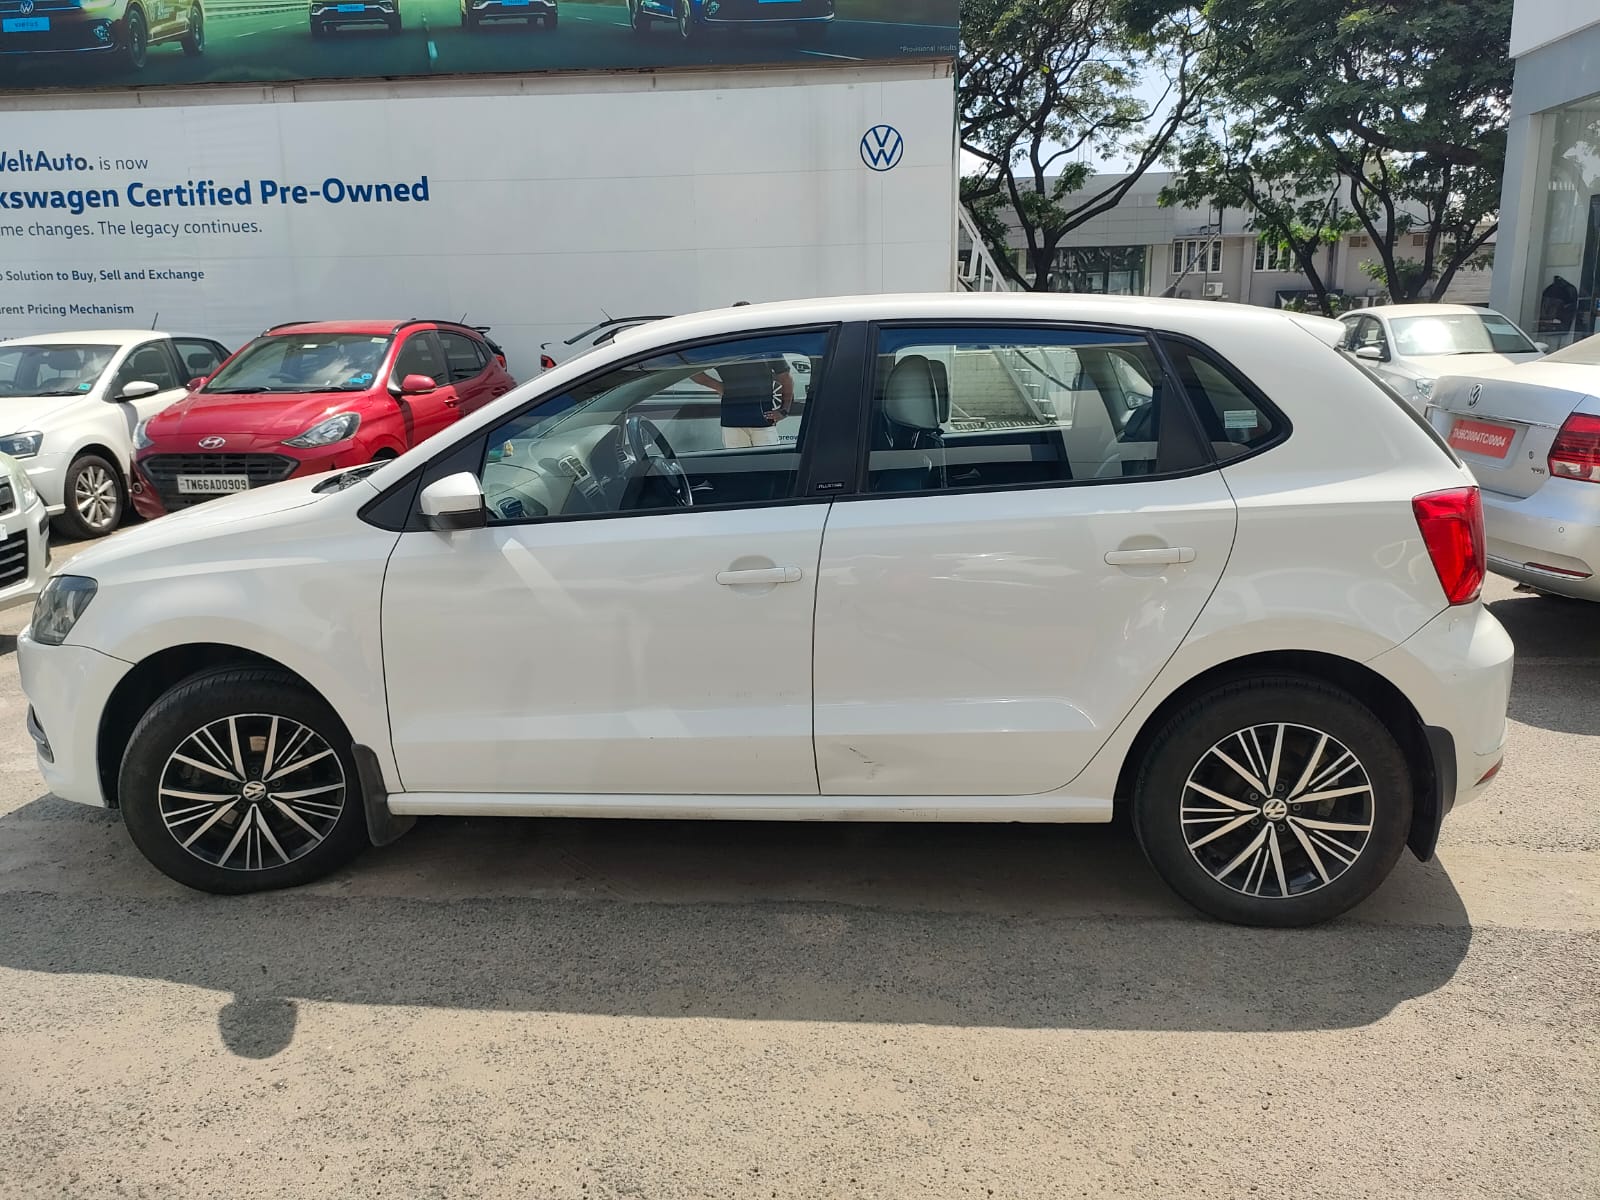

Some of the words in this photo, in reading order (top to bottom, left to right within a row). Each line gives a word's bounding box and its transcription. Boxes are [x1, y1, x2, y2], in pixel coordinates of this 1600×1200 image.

[0, 149, 94, 172] eltAuto.
[98, 156, 111, 170] is
[115, 158, 149, 170] now
[126, 179, 252, 207] Certified
[259, 175, 430, 204] Pre-Owned
[28, 221, 94, 239] changes.
[97, 220, 126, 235] The
[130, 219, 180, 238] legacy
[183, 219, 263, 234] continues.
[5, 270, 54, 281] Solution
[56, 270, 69, 281] to
[71, 270, 97, 283] Buy,
[99, 269, 121, 281] Sell
[123, 269, 146, 280] and
[148, 268, 205, 281] Exchange
[27, 303, 67, 317] Pricing
[69, 302, 135, 315] Mechanism
[184, 479, 248, 490] TN66AD0909
